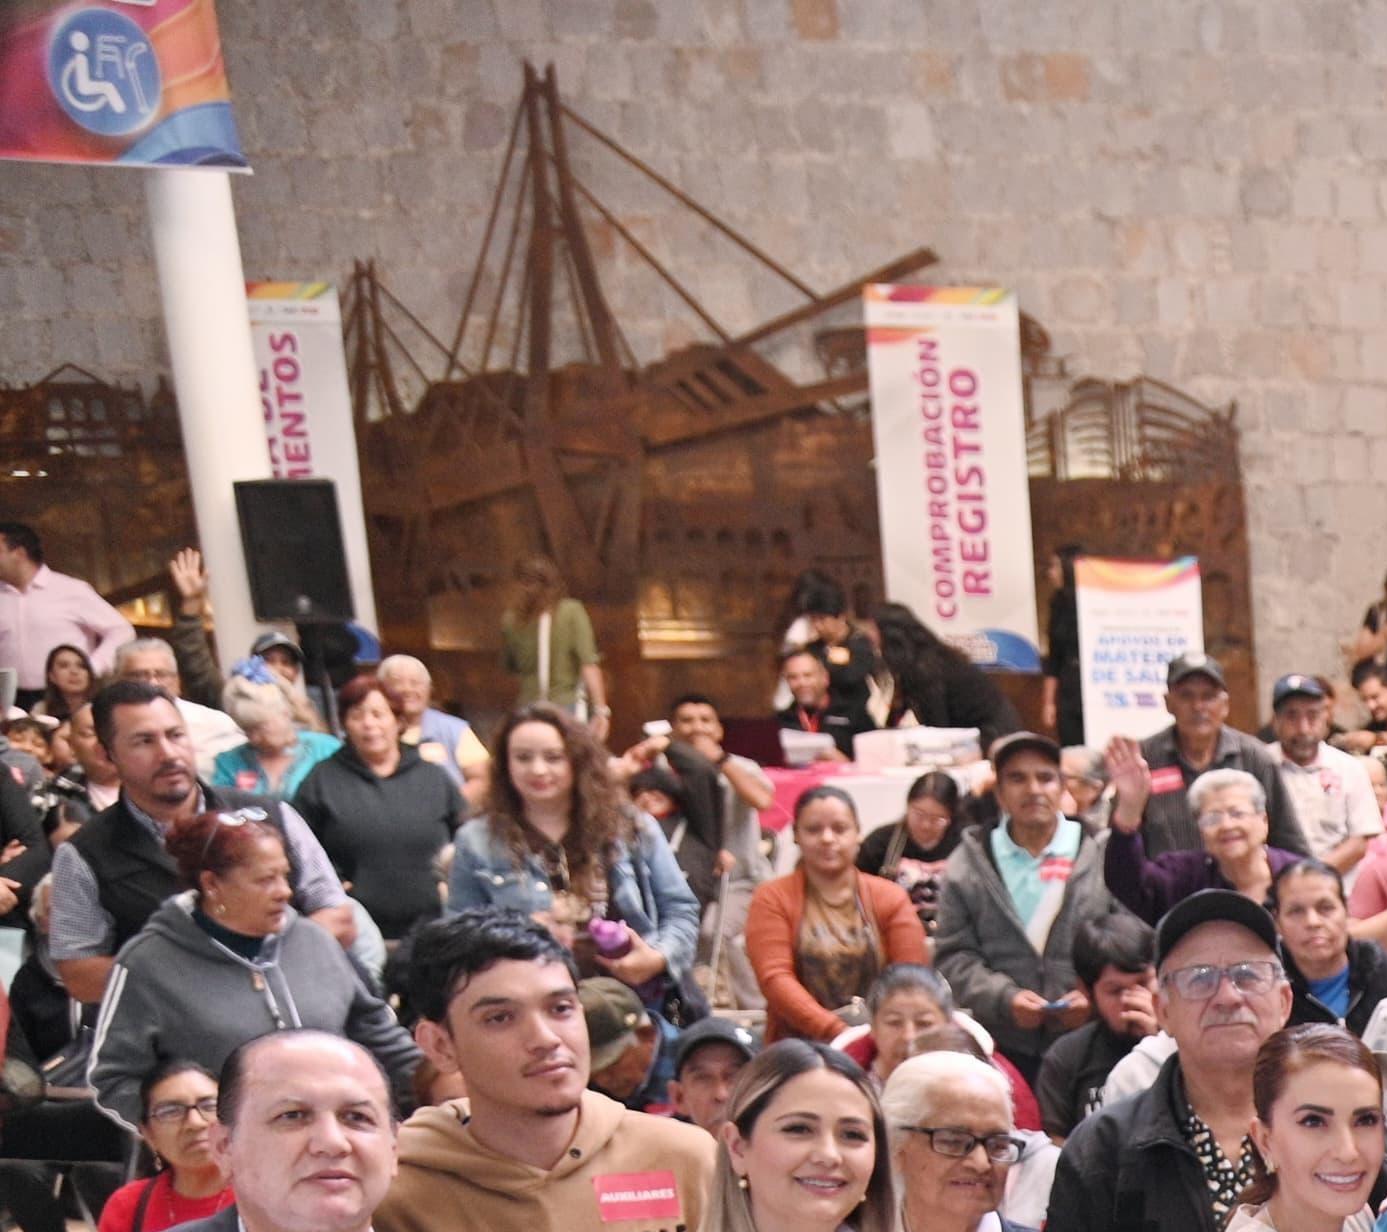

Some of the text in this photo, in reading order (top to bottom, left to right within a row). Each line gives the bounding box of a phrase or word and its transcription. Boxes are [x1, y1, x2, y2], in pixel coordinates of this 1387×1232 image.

[915, 338, 957, 620] COMPROBACIÓN
[949, 367, 992, 597] REGISTRO
[1125, 670, 1166, 683] SAL
[600, 1187, 675, 1204] AUXILIARES
